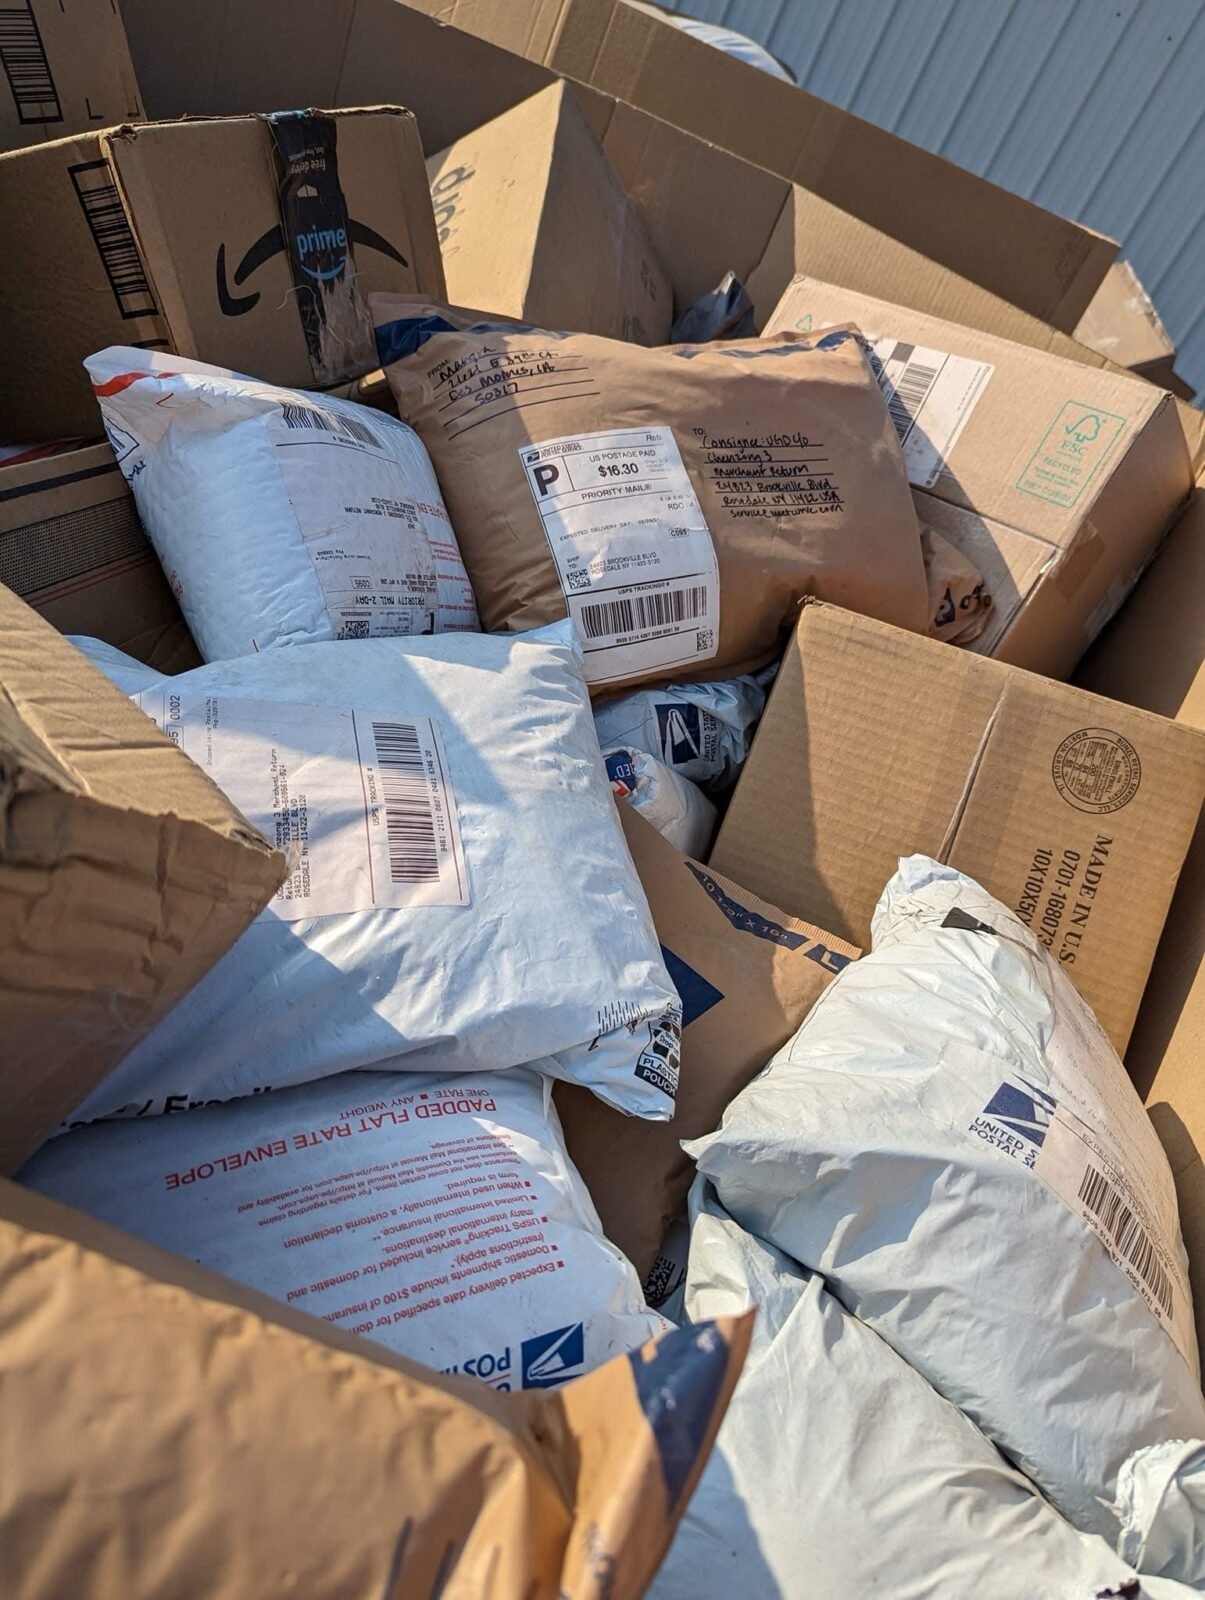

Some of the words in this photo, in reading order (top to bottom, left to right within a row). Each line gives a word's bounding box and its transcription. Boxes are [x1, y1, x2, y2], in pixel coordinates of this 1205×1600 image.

[296, 224, 347, 261] prime
[693, 427, 706, 436] TO:
[589, 454, 600, 463] US
[601, 451, 638, 462] POSTAGE
[1060, 440, 1089, 457] FSC
[598, 462, 639, 478] $16.30
[533, 464, 560, 497] P
[715, 481, 753, 492] 24823
[581, 487, 622, 501] PRIORITY
[668, 502, 685, 511] RDC
[560, 530, 589, 542] EXPECTED
[590, 524, 618, 534] DELIVERY
[566, 555, 580, 564] SHIP
[607, 553, 642, 566] BROOKVILLE
[642, 552, 657, 560] BLVD
[354, 579, 371, 589] C095
[617, 588, 633, 596] USPS
[355, 596, 377, 606] 2-DAY
[379, 596, 396, 605] MAIL
[398, 596, 425, 606] PRIORITY
[170, 695, 181, 721] 0002
[710, 734, 718, 763] POSTAL
[1060, 731, 1089, 754] MORTON
[1116, 737, 1134, 757] BUNZL
[270, 748, 278, 771] Return
[1104, 760, 1122, 794] SINGLEWALL
[1130, 758, 1139, 781] RETAIL
[368, 774, 379, 805] TRACKING
[274, 811, 281, 819] 3
[290, 798, 299, 817] BLVD
[1097, 805, 1111, 813] LLC
[371, 807, 381, 826] USPS
[437, 814, 446, 834] 2111
[1078, 834, 1114, 900] MADE
[294, 873, 303, 899] 24823
[302, 859, 310, 898] ROSEDALE
[702, 875, 716, 893] 10
[761, 925, 788, 940] 16"
[1036, 849, 1081, 952] 0701-168073
[1069, 900, 1092, 929] IN
[1057, 931, 1083, 965] U.S.
[642, 1057, 679, 1085] PLASTIC
[642, 1069, 676, 1097] POUCH
[390, 1094, 415, 1108] ANY
[433, 1089, 464, 1099] RATE
[464, 1089, 489, 1097] ONE
[338, 1102, 388, 1120] WEIGHT
[414, 1098, 496, 1119] PADDED
[358, 1109, 410, 1133] FLAT
[292, 1122, 352, 1150] RATE
[968, 1124, 1017, 1159] POSTAL
[974, 1116, 1025, 1150] UNITED
[429, 1151, 445, 1160] Mail
[447, 1144, 492, 1156] International
[164, 1139, 288, 1190] ENVELOPE
[400, 1154, 428, 1166] Manual
[415, 1160, 451, 1172] Domestic
[464, 1161, 483, 1170] does
[367, 1173, 396, 1186] Manual
[397, 1168, 414, 1178] Mail
[399, 1174, 426, 1186] certain
[427, 1169, 449, 1178] cover
[1101, 1164, 1126, 1196] USPS
[301, 1184, 313, 1192] for
[444, 1176, 487, 1190] required.
[472, 1184, 495, 1199] used
[496, 1179, 524, 1192] When
[255, 1189, 299, 1206] availability
[329, 1193, 356, 1205] details
[358, 1188, 372, 1197] For
[494, 1194, 530, 1206] Limited
[238, 1202, 254, 1214] and
[287, 1201, 328, 1218] regarding
[399, 1189, 471, 1215] internationally,
[433, 1200, 494, 1221] international
[258, 1213, 286, 1227] claims
[344, 1210, 389, 1230] customs
[390, 1208, 397, 1216] a
[509, 1208, 534, 1218] many
[1081, 1211, 1099, 1230] 9505
[447, 1212, 508, 1236] international
[511, 1217, 540, 1230] USPS
[283, 1225, 343, 1249] declaration
[381, 1229, 447, 1255] destinations.
[489, 1232, 545, 1255] (restrictions
[378, 1247, 424, 1264] included
[425, 1238, 462, 1256] service
[504, 1243, 550, 1265] Domestic
[362, 1262, 378, 1276] for
[450, 1258, 503, 1281] shipments
[509, 1260, 556, 1284] Expected
[309, 1269, 360, 1294] domestic
[411, 1275, 450, 1294] include
[468, 1277, 508, 1296] delivery
[285, 1286, 308, 1303] and
[383, 1287, 410, 1306] $100
[443, 1289, 467, 1305] date
[369, 1298, 381, 1311] of
[393, 1297, 441, 1321] specified
[376, 1313, 392, 1329] for
